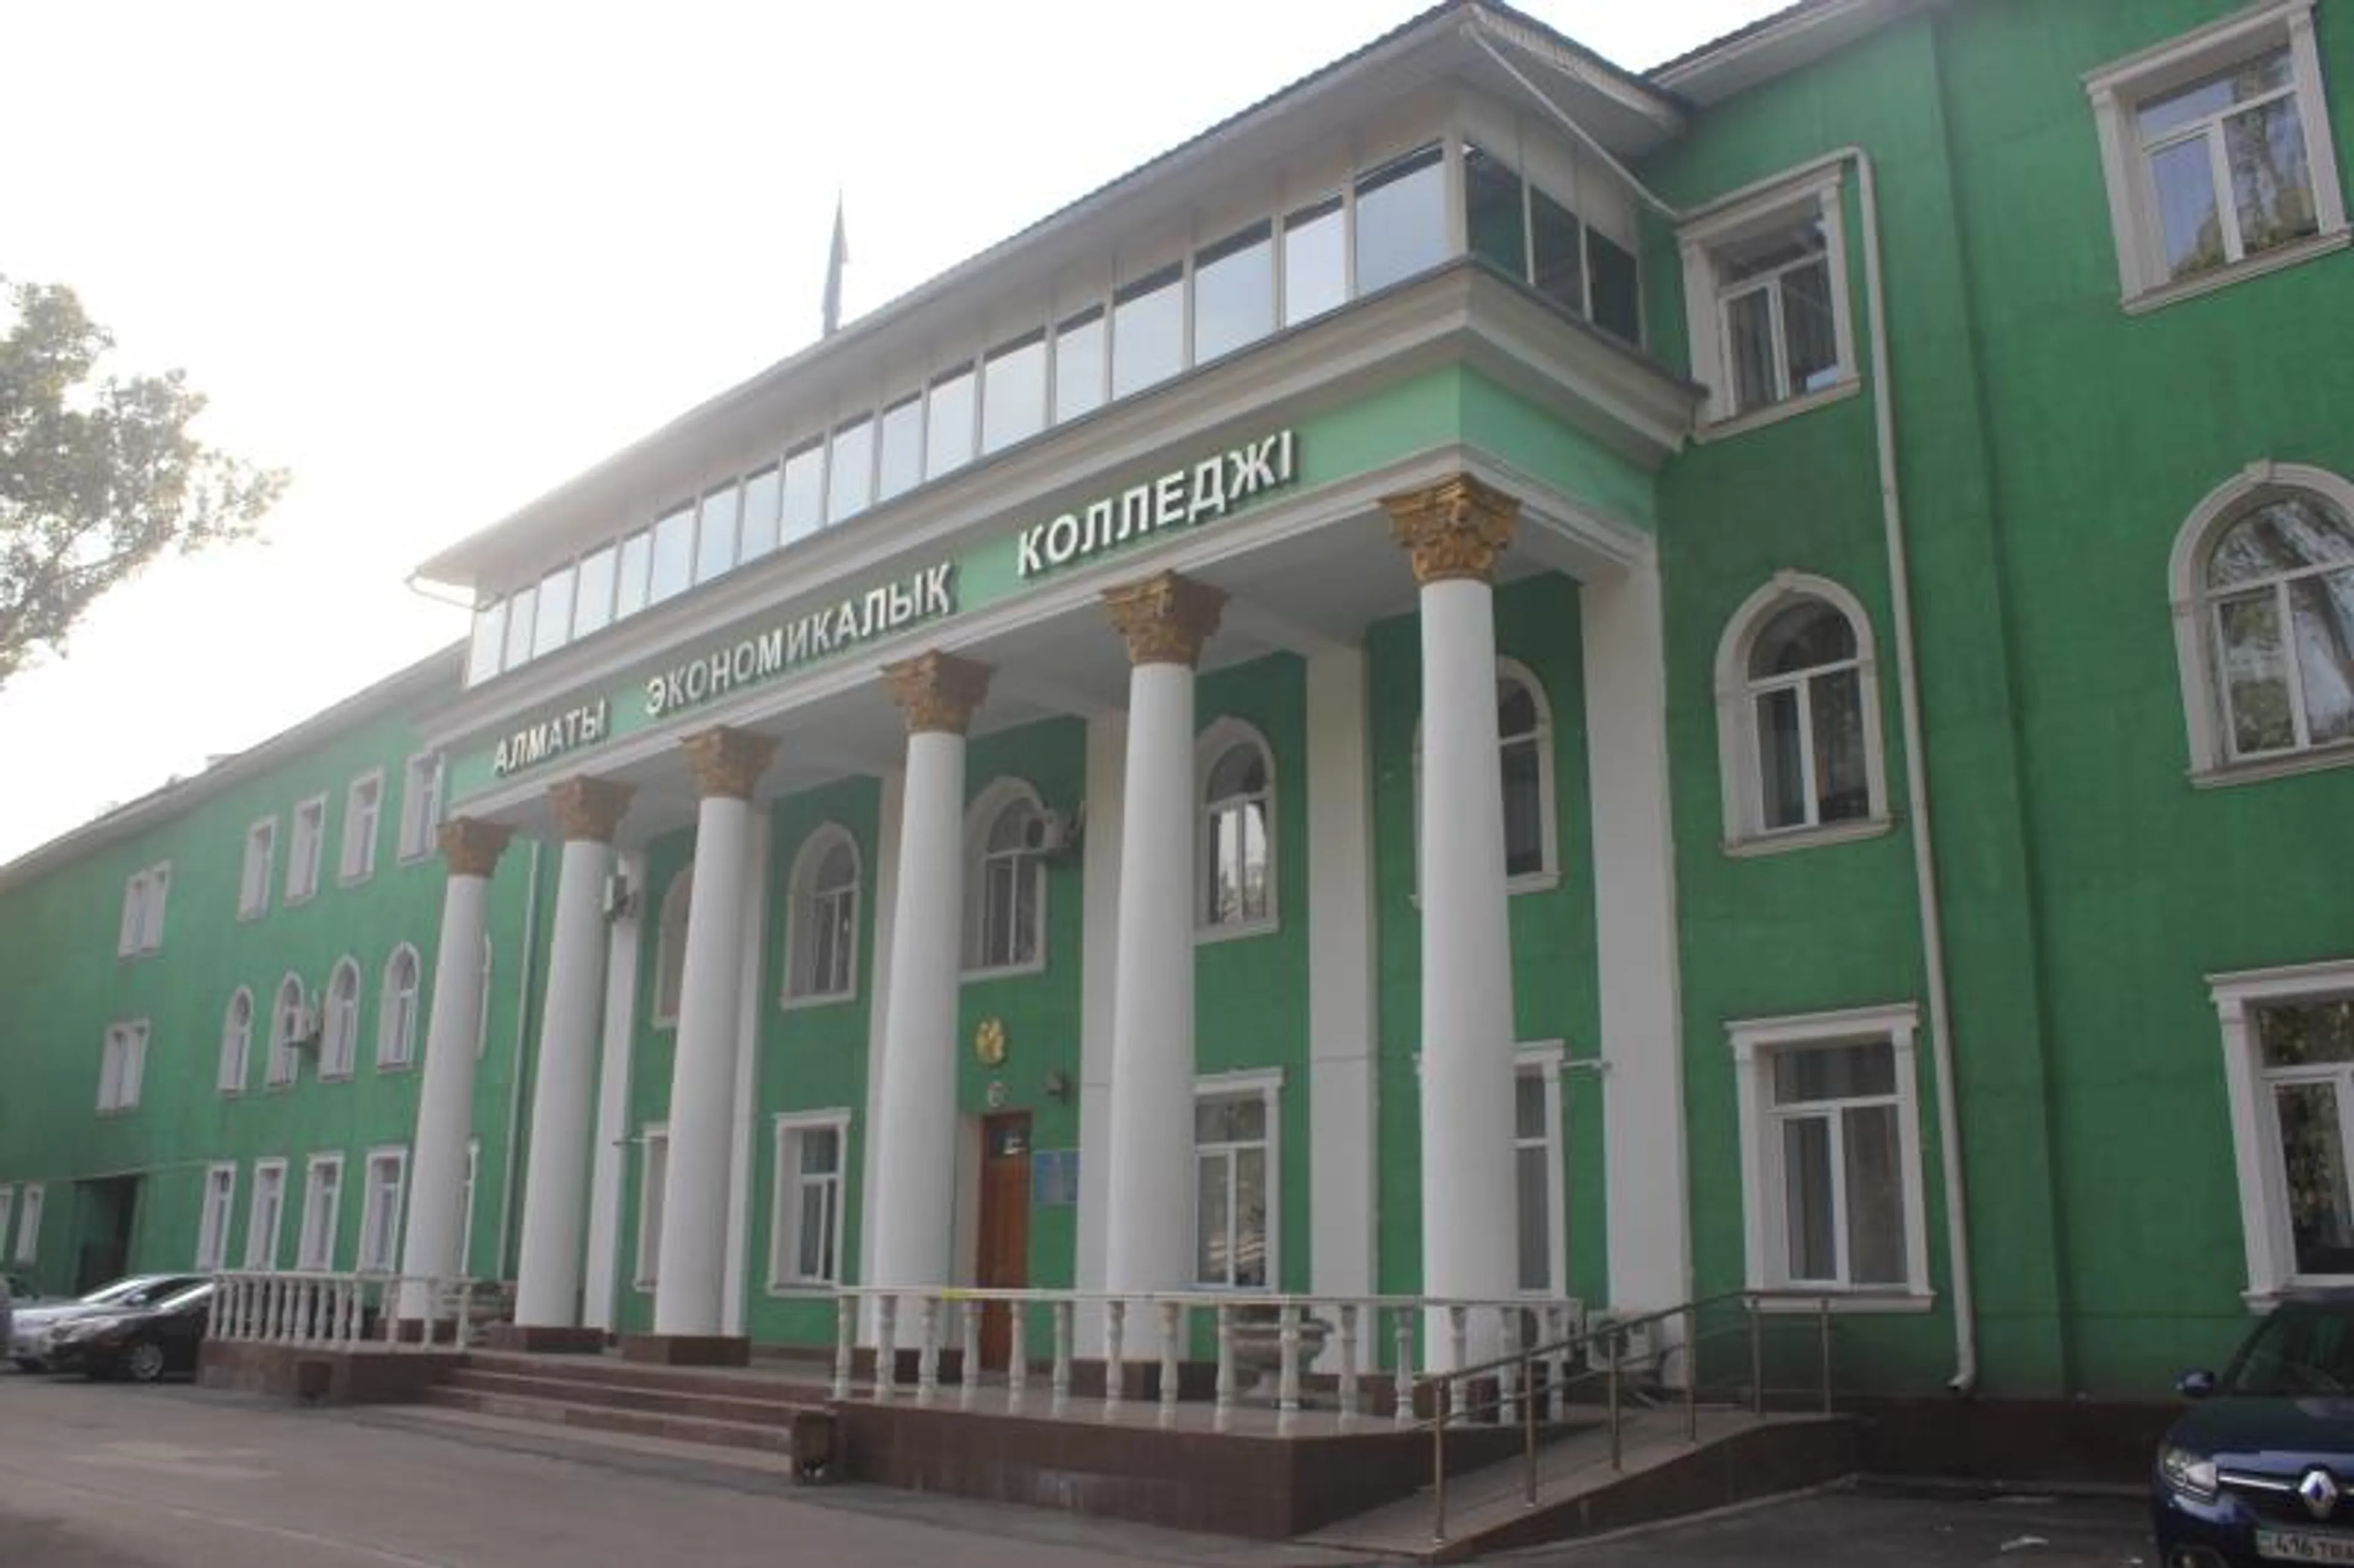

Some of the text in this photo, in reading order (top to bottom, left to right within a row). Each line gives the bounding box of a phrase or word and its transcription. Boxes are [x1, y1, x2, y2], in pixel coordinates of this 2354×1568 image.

[494, 429, 1292, 775] АЛМАТЫ ЭКОНОМИКАЛЫҚ КОЛЛЕДЖІ
